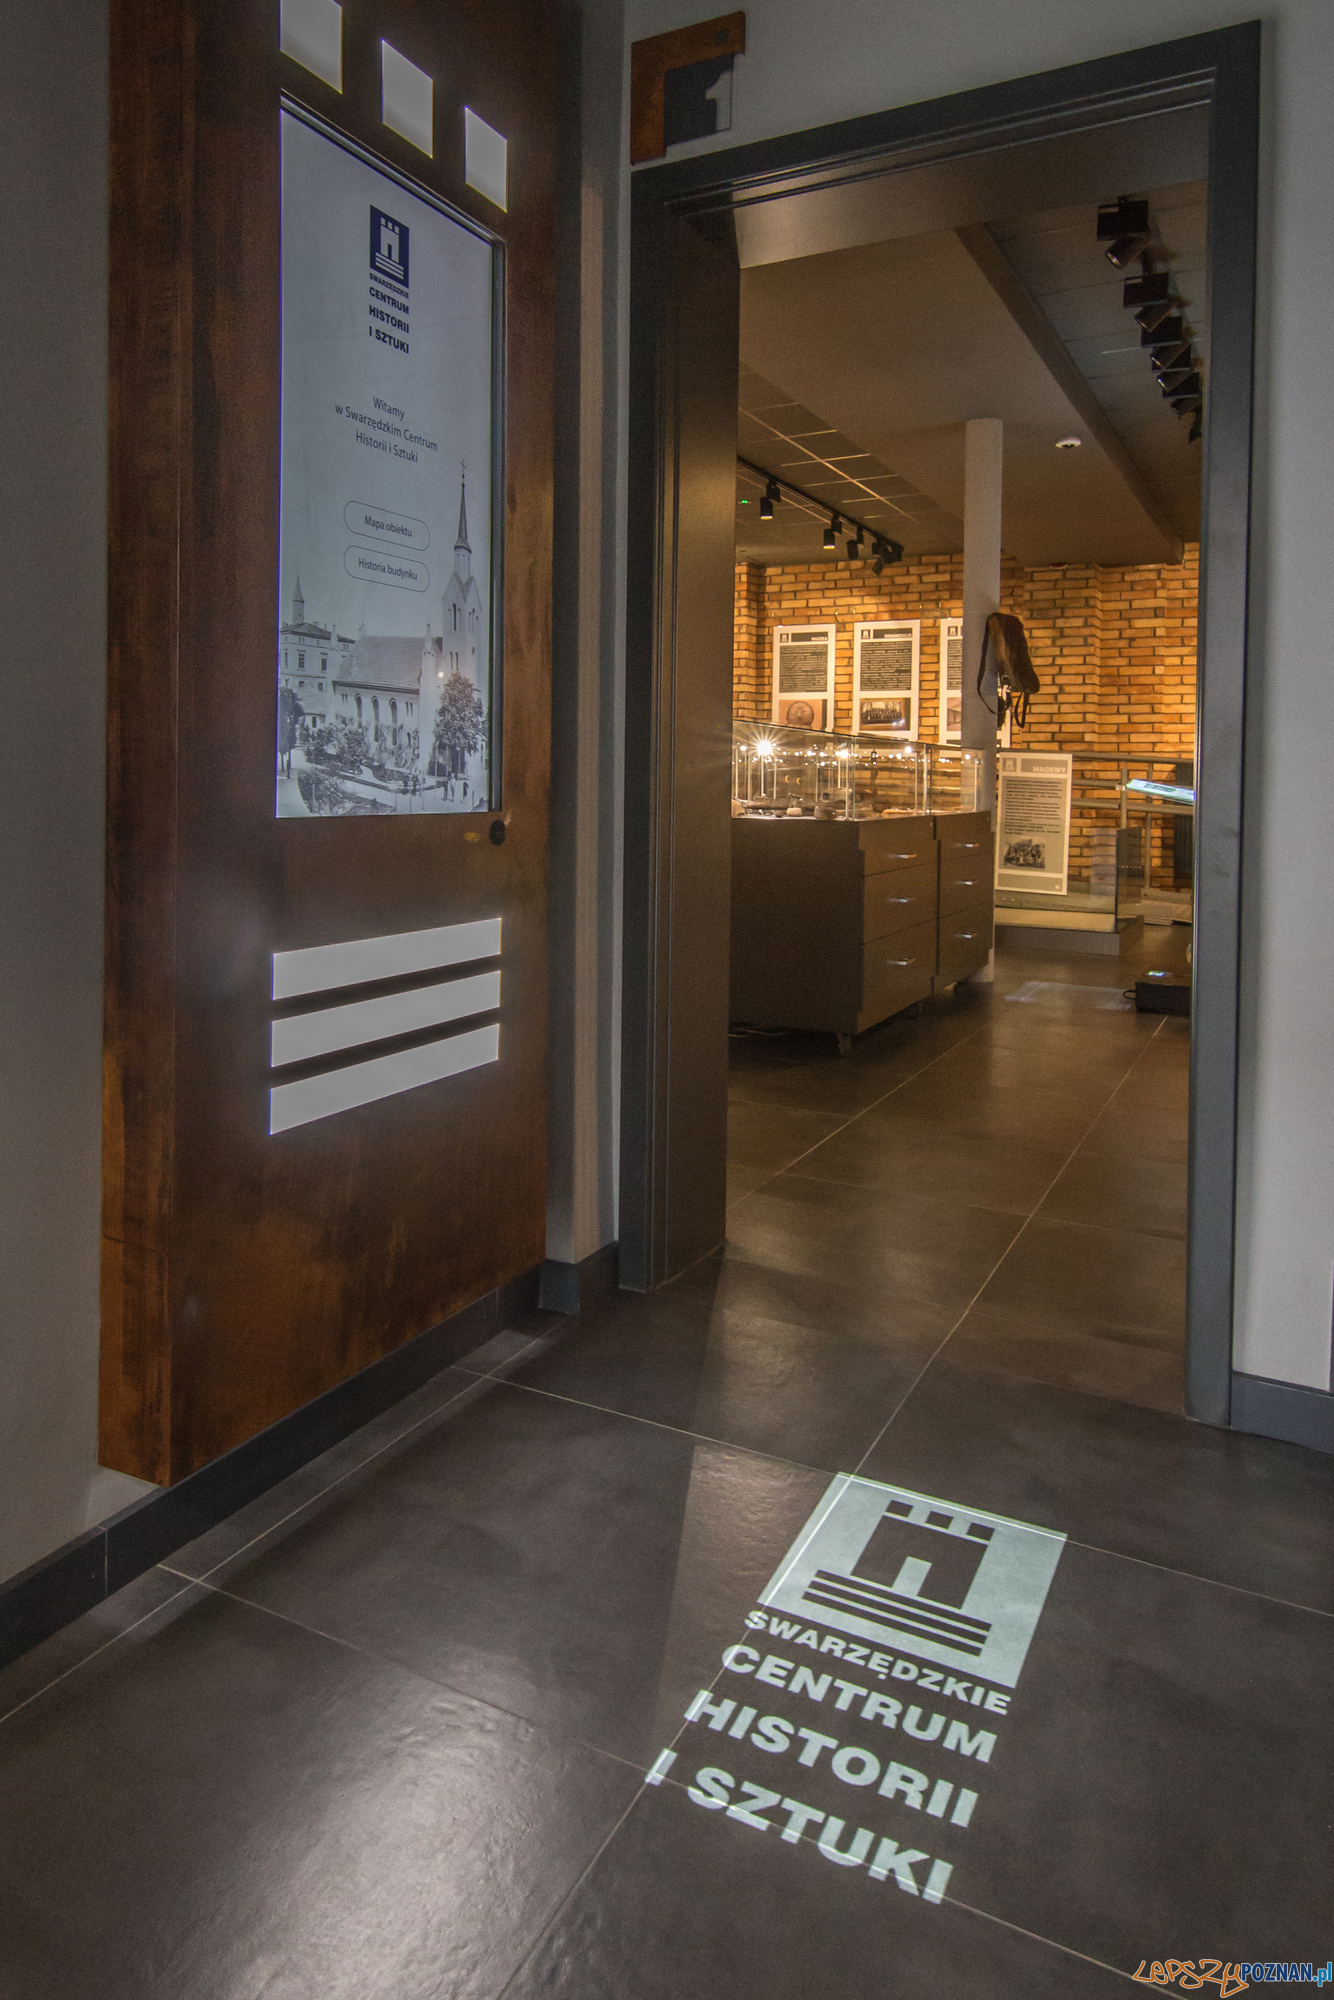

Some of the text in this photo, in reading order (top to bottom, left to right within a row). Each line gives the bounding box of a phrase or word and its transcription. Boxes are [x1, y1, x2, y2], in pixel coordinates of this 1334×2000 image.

[369, 272, 410, 300] SWARZĘDZKIE
[369, 286, 410, 315] CENTRUM
[369, 304, 410, 334] HISTORII
[369, 325, 410, 354] I SZTUKI
[373, 396, 405, 421] Witamy
[335, 404, 438, 451] w Swarzędzkim Centrum
[355, 430, 418, 463] Historii i Sztuki
[364, 514, 412, 537] Mapa obiektu
[358, 557, 418, 581] Historia budynku
[744, 1610, 1012, 1716] SWARZĘDZKIE
[721, 1644, 998, 1763] CENTRUM
[684, 1689, 979, 1828] HISTORII
[645, 1748, 954, 1905] I SZTUKI
